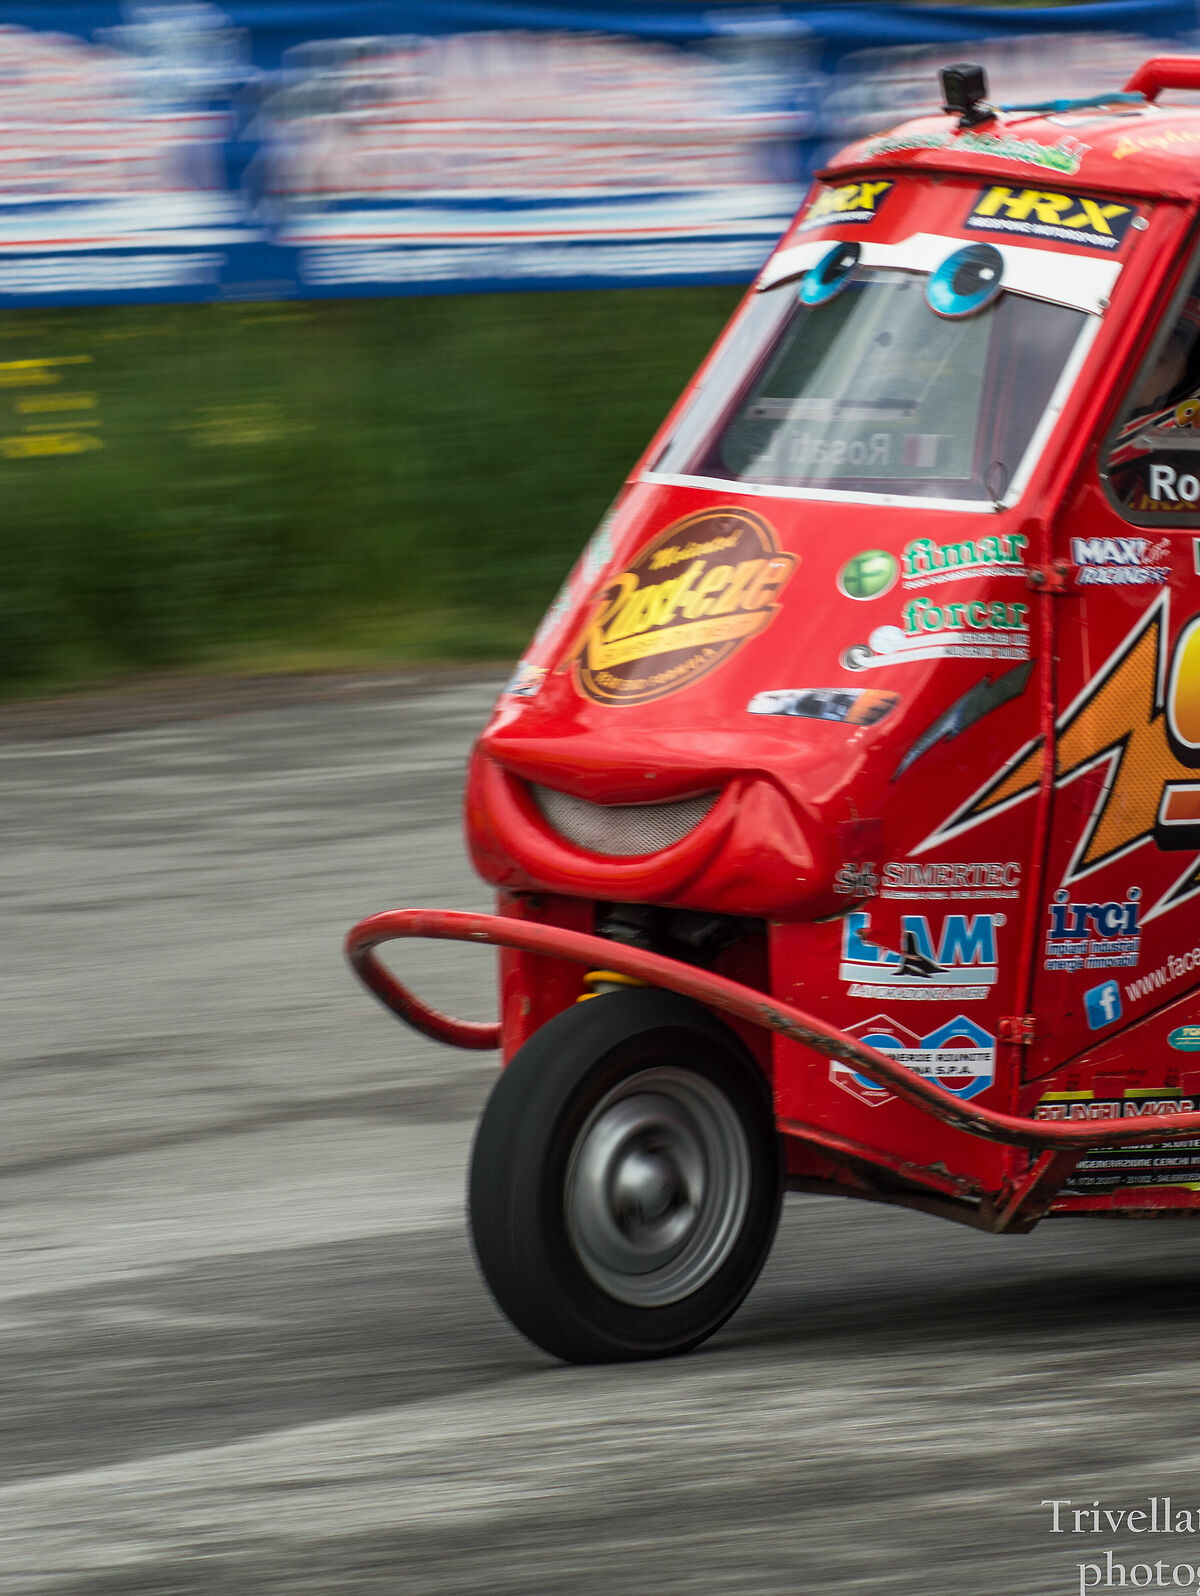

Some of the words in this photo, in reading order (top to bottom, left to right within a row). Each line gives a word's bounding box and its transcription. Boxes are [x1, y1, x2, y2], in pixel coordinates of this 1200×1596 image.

[973, 186, 1131, 236] HRX
[902, 537, 1030, 580] fimar
[902, 597, 1030, 636] forcar
[881, 861, 1021, 888] SIMERTEC
[1046, 886, 1143, 939] irci
[1075, 1158, 1152, 1169] IGENERAZIONE
